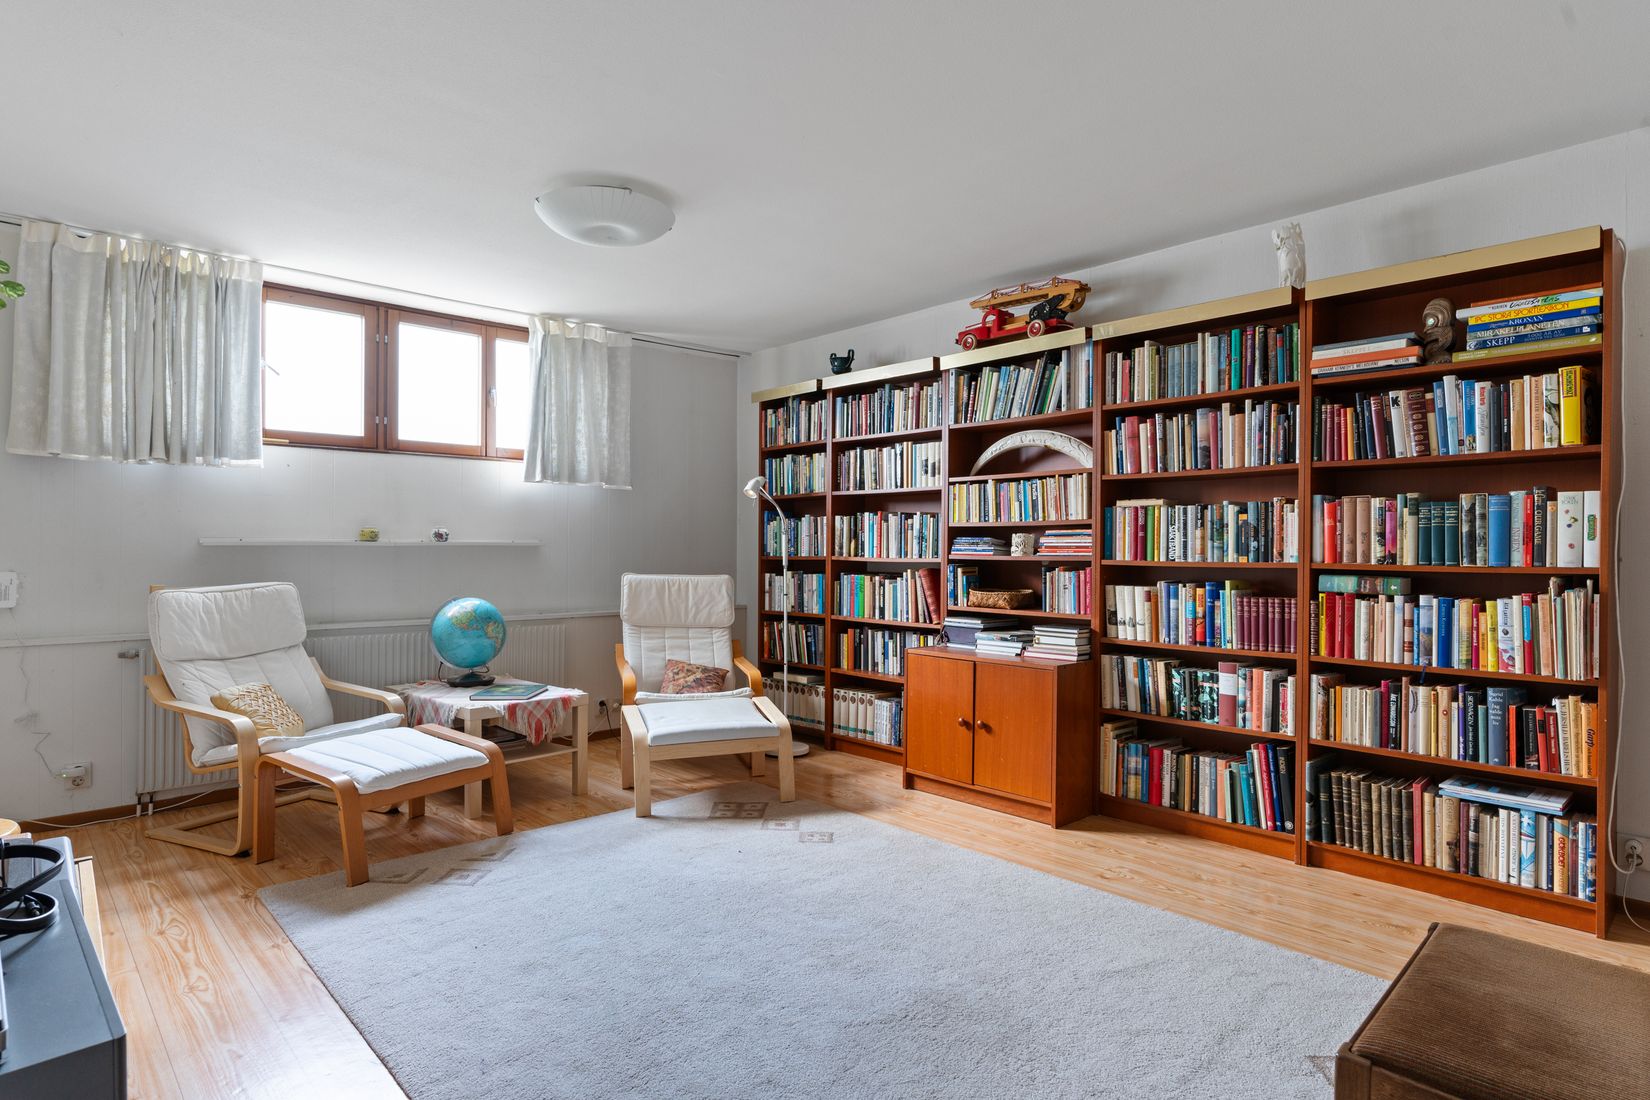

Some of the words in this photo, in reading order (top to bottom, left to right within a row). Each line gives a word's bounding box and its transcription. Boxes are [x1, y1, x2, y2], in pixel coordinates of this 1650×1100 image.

[1486, 336, 1516, 348] SKEPP
[1585, 728, 1596, 748] Garp
[1558, 837, 1566, 868] GÖKBOET
